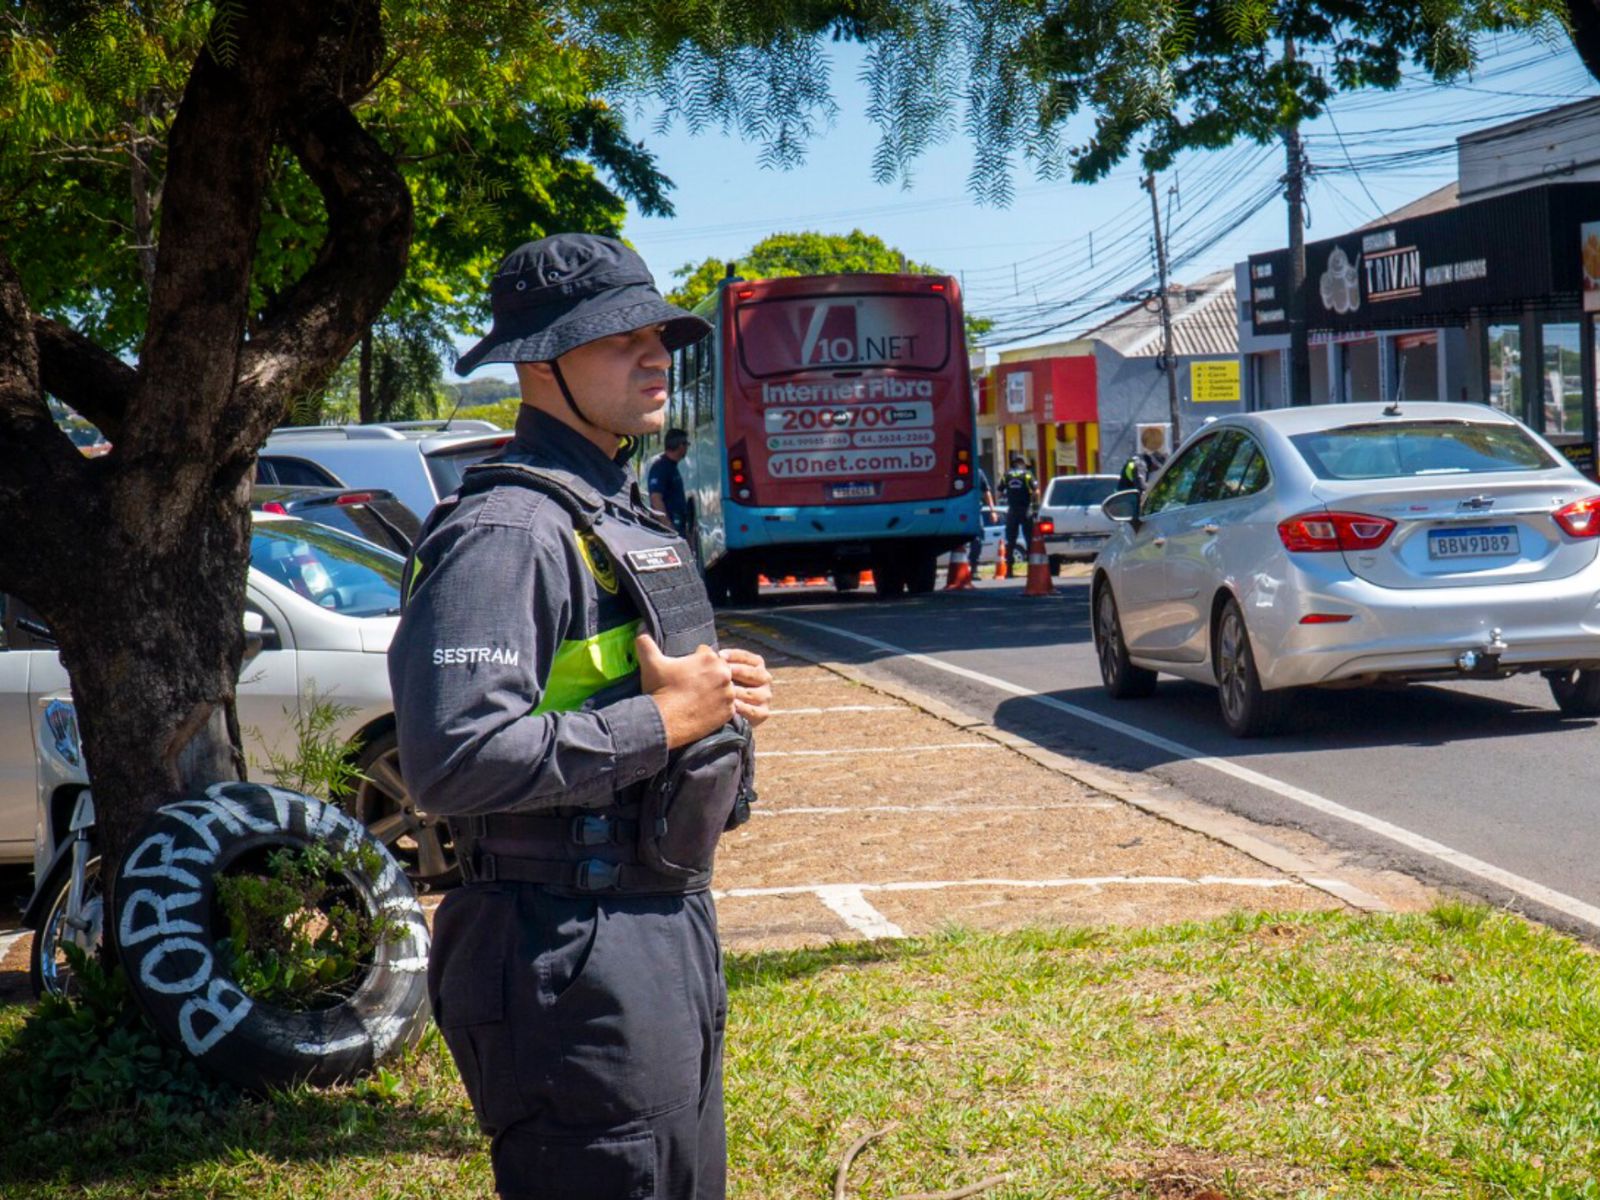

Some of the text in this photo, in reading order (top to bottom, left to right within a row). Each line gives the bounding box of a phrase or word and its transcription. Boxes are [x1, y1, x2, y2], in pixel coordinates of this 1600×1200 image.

[1365, 250, 1420, 294] TRIVAN
[762, 378, 932, 404] Internet Fibra
[771, 452, 933, 475] v10net.com.br
[1437, 535, 1510, 555] BBW9D89
[432, 648, 518, 667] SESTRAM
